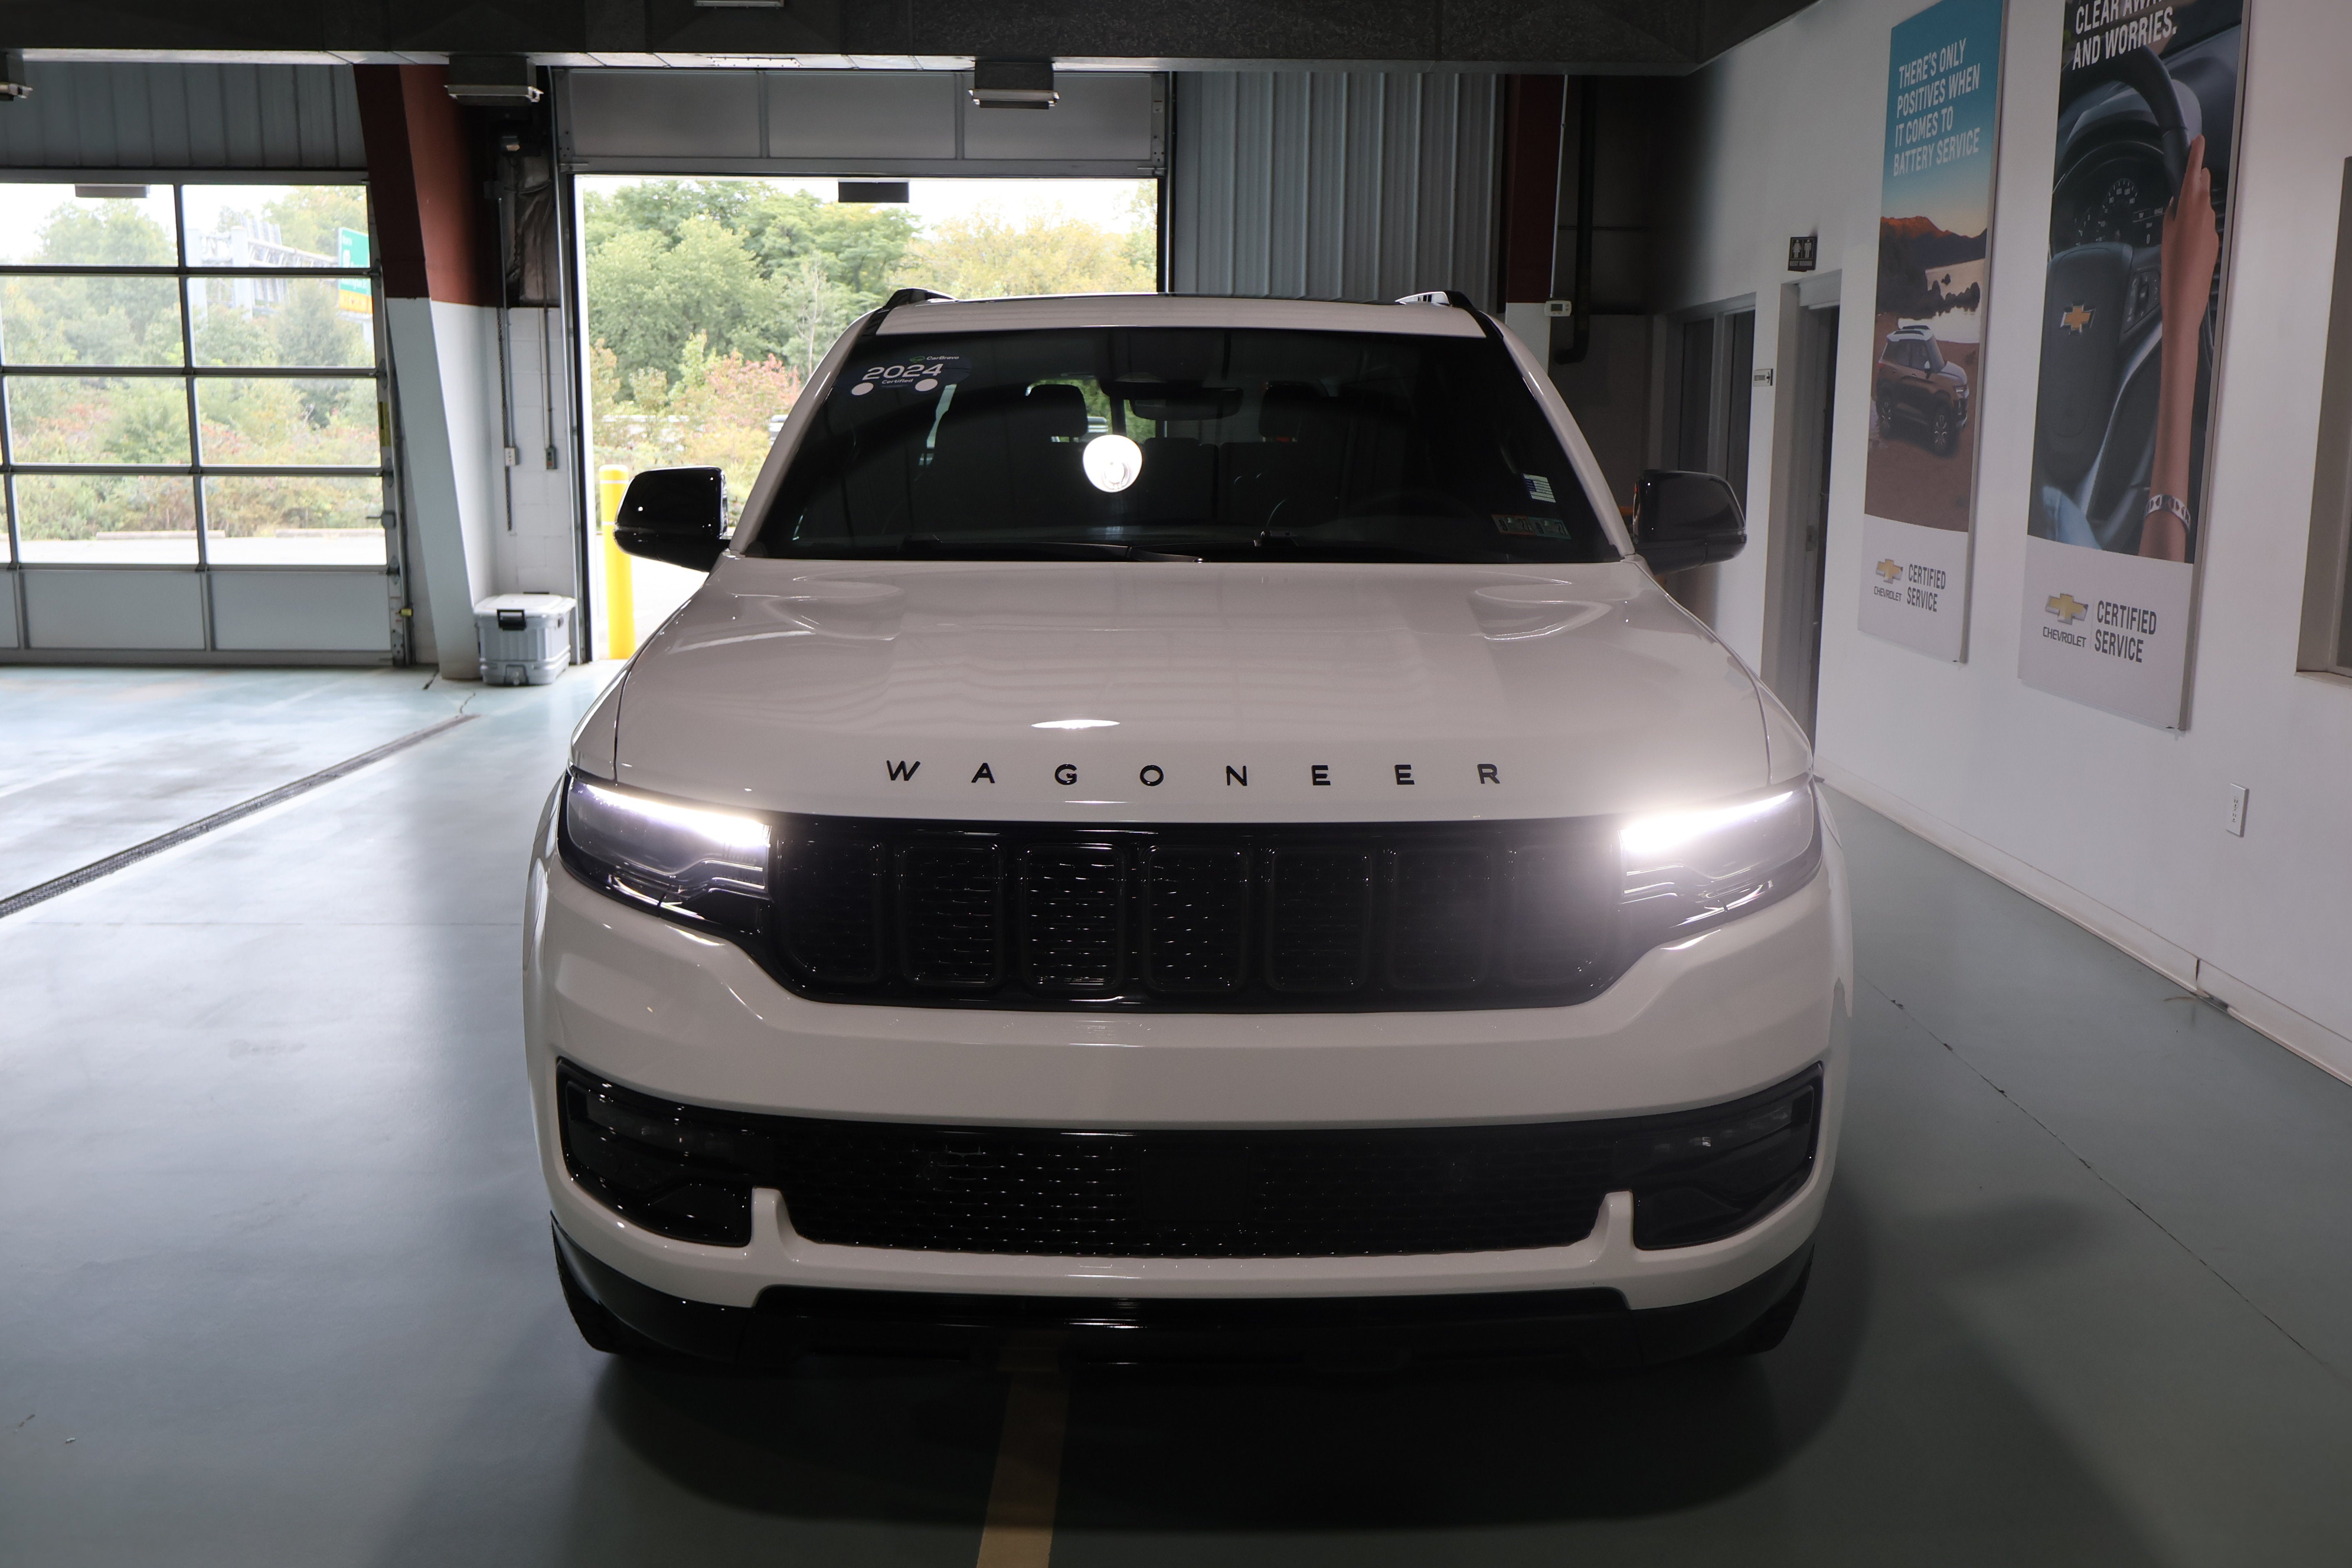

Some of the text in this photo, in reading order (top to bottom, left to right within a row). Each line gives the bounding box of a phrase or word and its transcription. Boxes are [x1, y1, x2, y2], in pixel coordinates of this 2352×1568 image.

[2076, 0, 2119, 34] CLEAR
[1899, 38, 1966, 89] THERE'S ONLY
[2072, 35, 2101, 70] AND
[1897, 63, 1980, 118] POSITIVES WHEN
[1895, 106, 1953, 148] IT COMES TO
[1893, 127, 1980, 176] BATTERY SERVICE
[862, 363, 944, 381] 2024
[1874, 586, 1902, 602] CHEVROLET
[1909, 564, 1946, 590] CERTIFIED
[1907, 586, 1938, 612] SERVICE
[2097, 600, 2157, 635] CERTIFIED
[2043, 626, 2087, 647] CHEVROLET
[2095, 629, 2144, 663] SERVICE
[886, 760, 1500, 786] WAGONEER
